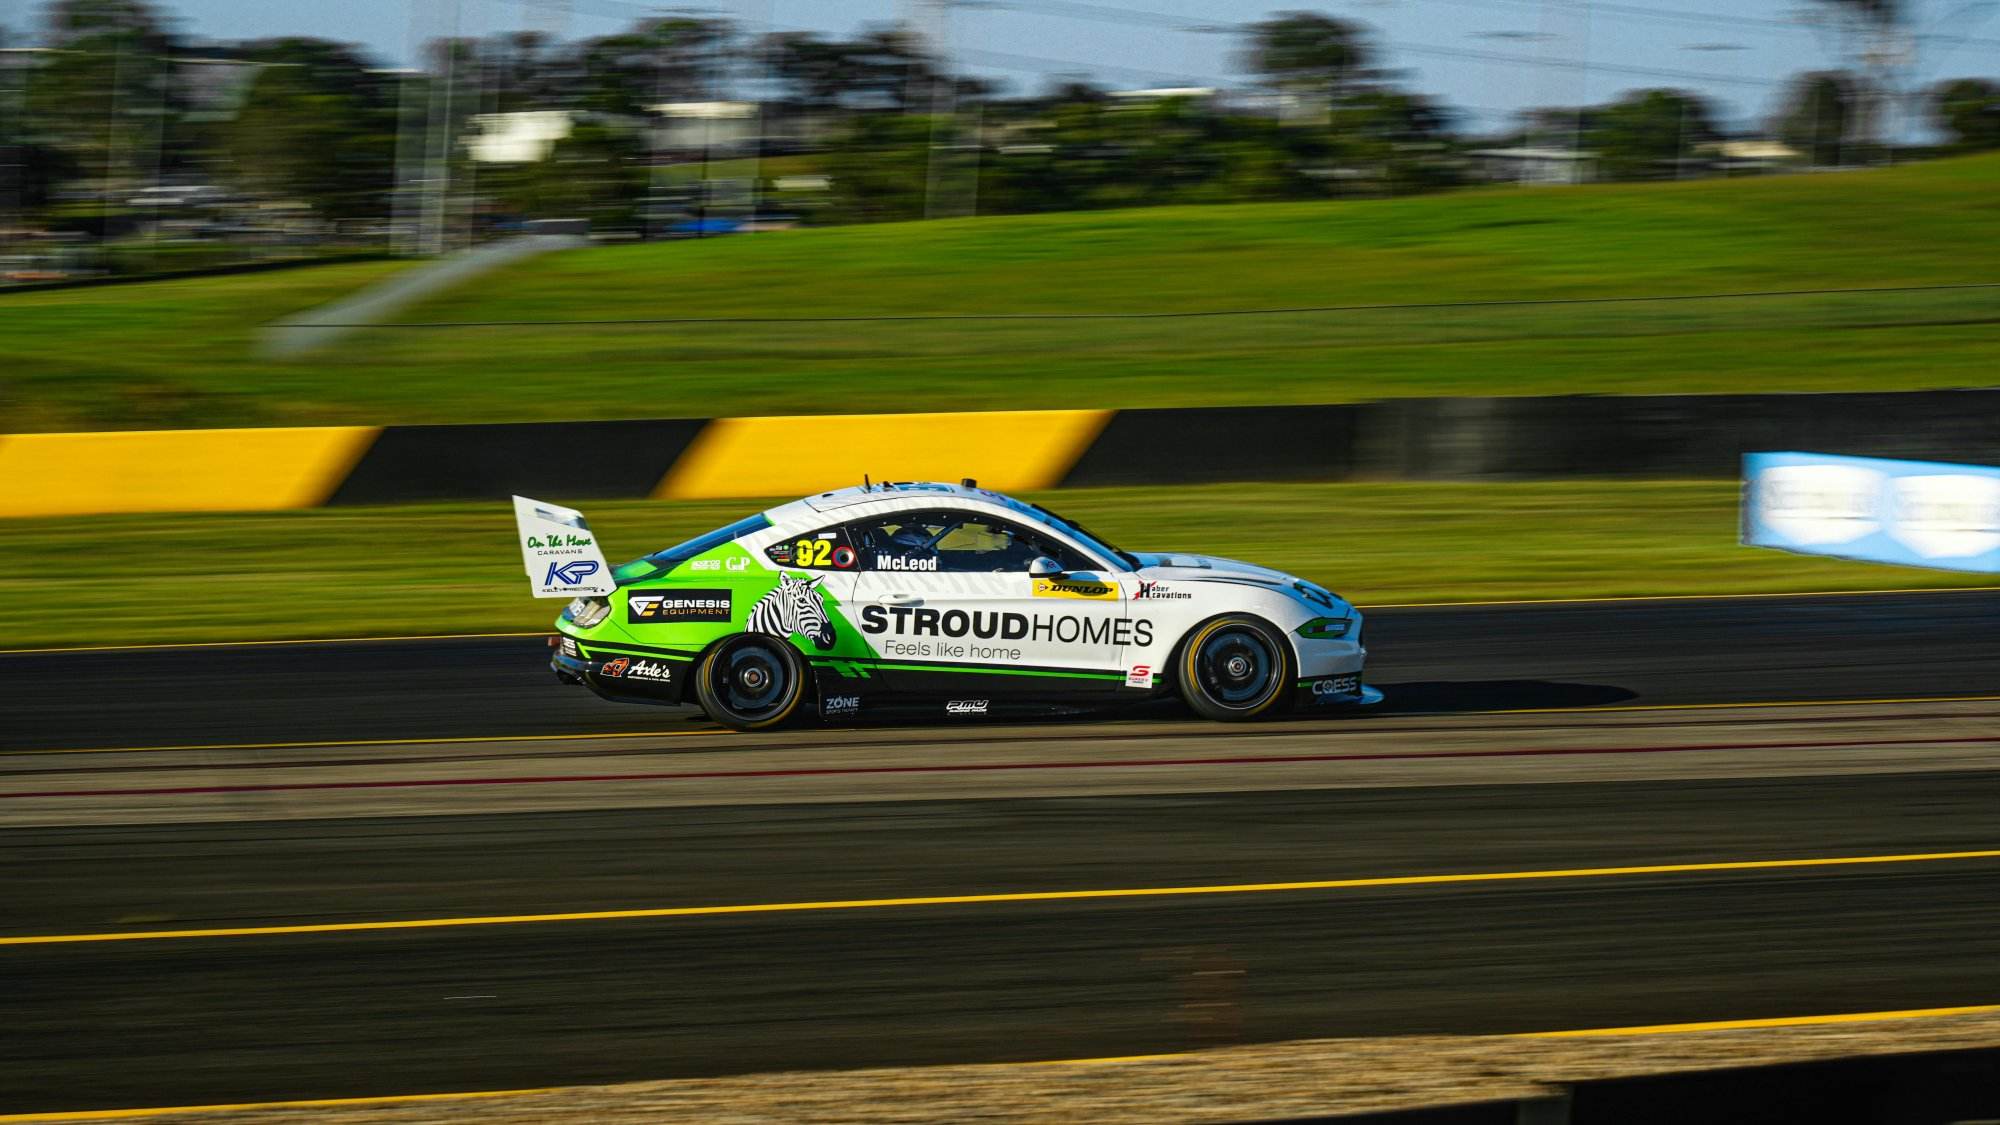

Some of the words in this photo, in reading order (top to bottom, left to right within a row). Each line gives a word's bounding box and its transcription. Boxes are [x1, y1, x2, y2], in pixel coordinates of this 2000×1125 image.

[528, 536, 544, 548] On
[547, 534, 562, 547] The
[796, 539, 832, 567] 92
[877, 554, 937, 571] McLeod
[545, 560, 600, 586] KP
[1050, 584, 1114, 594] DUNLOP
[662, 599, 730, 609] GENESIS
[885, 640, 931, 656] Feels
[936, 642, 964, 657] like
[969, 643, 1021, 660] home
[627, 660, 671, 678] Axle's
